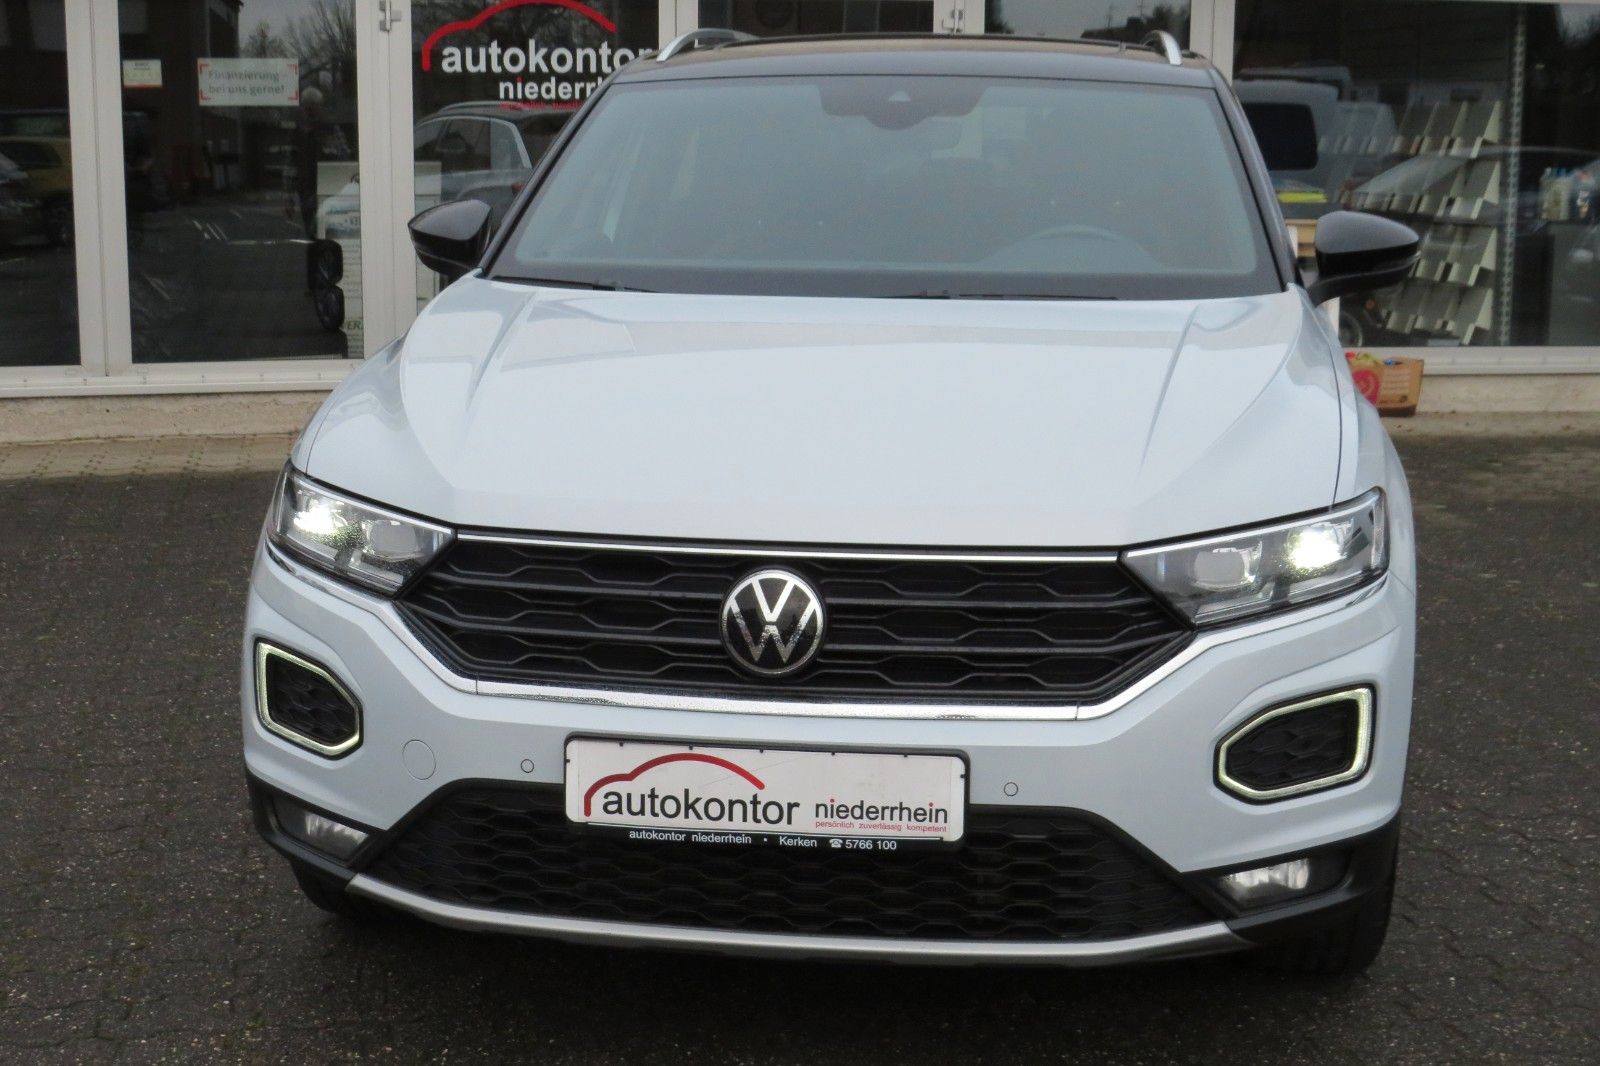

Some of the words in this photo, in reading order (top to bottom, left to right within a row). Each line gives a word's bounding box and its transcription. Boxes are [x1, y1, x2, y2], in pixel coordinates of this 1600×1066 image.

[208, 70, 280, 82] Finanzierung
[208, 84, 226, 95] bei
[228, 86, 248, 95] uns
[602, 786, 800, 825] autokontor
[815, 798, 948, 824] niederrhein
[815, 820, 855, 830] persönlich
[859, 822, 902, 832] zuverlässig
[906, 824, 947, 833] kompetent
[629, 829, 687, 842] autokontor
[692, 833, 752, 844] niederrhein
[779, 835, 818, 848] Kerken
[845, 839, 873, 850] 5766
[877, 841, 897, 850] 100
